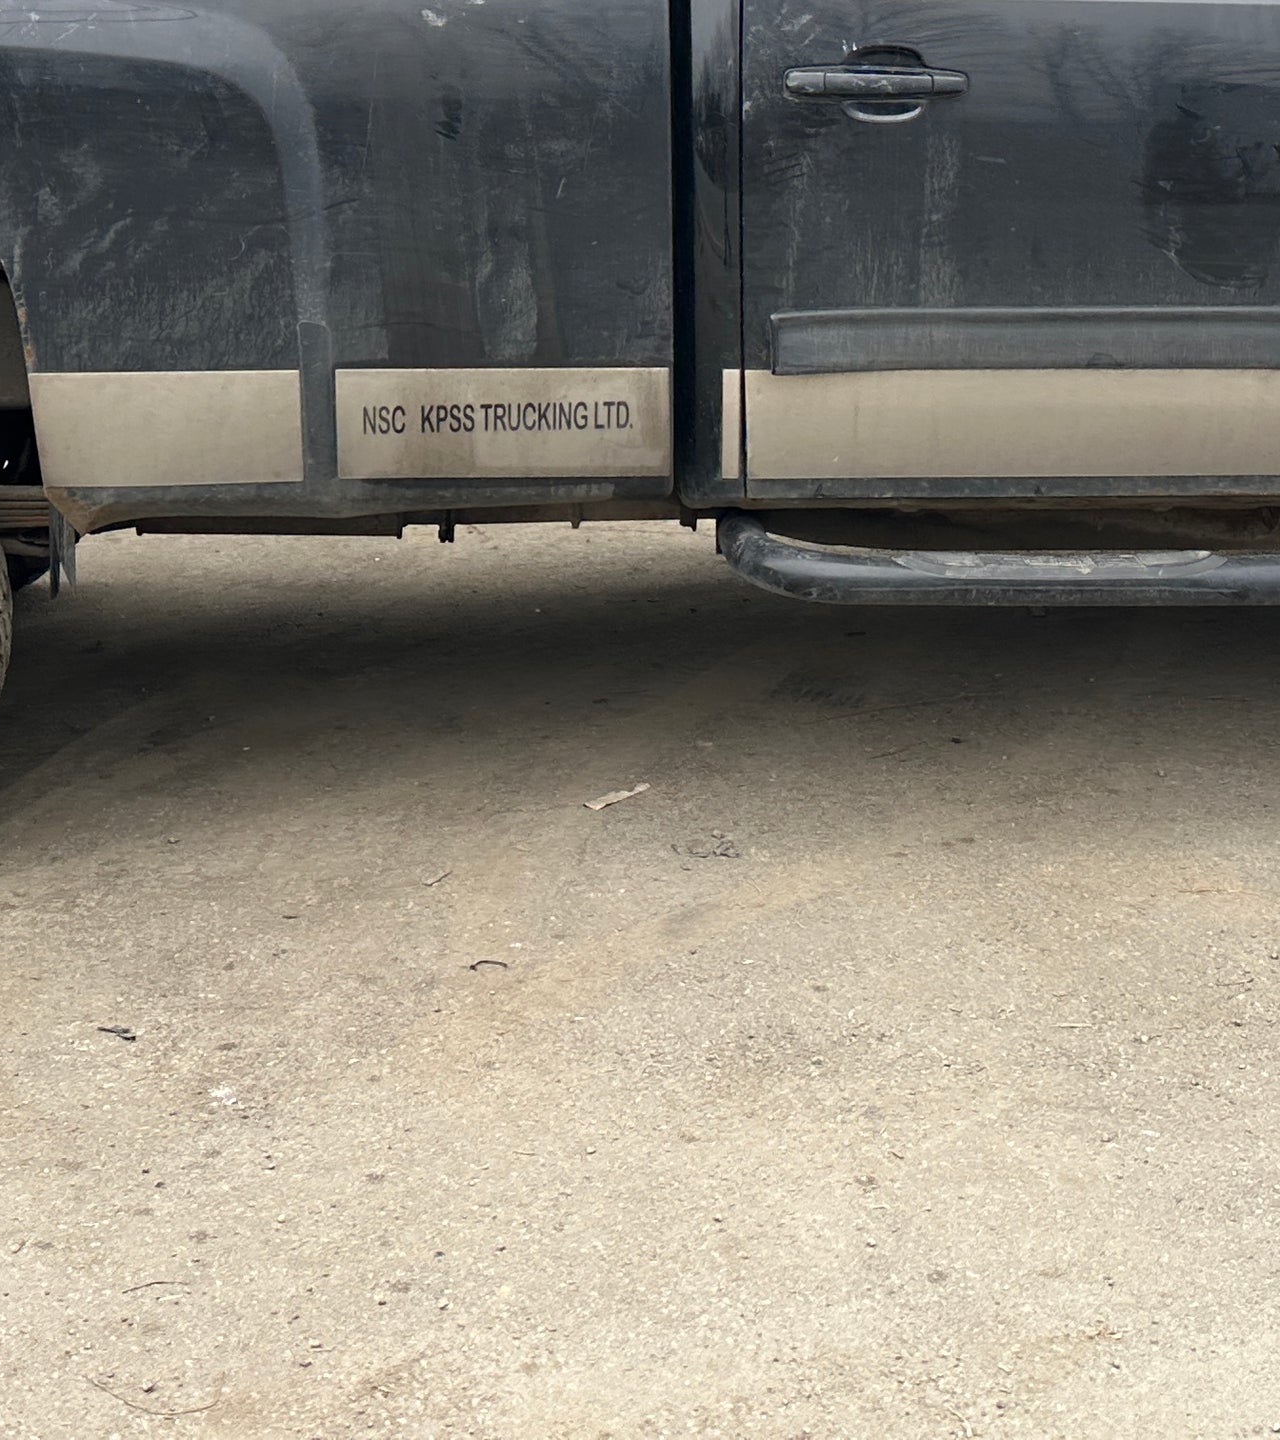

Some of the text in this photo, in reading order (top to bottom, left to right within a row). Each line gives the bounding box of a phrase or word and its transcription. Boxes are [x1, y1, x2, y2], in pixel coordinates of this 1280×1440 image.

[363, 401, 634, 435] NSC KPSS TRUCKING LTD.
